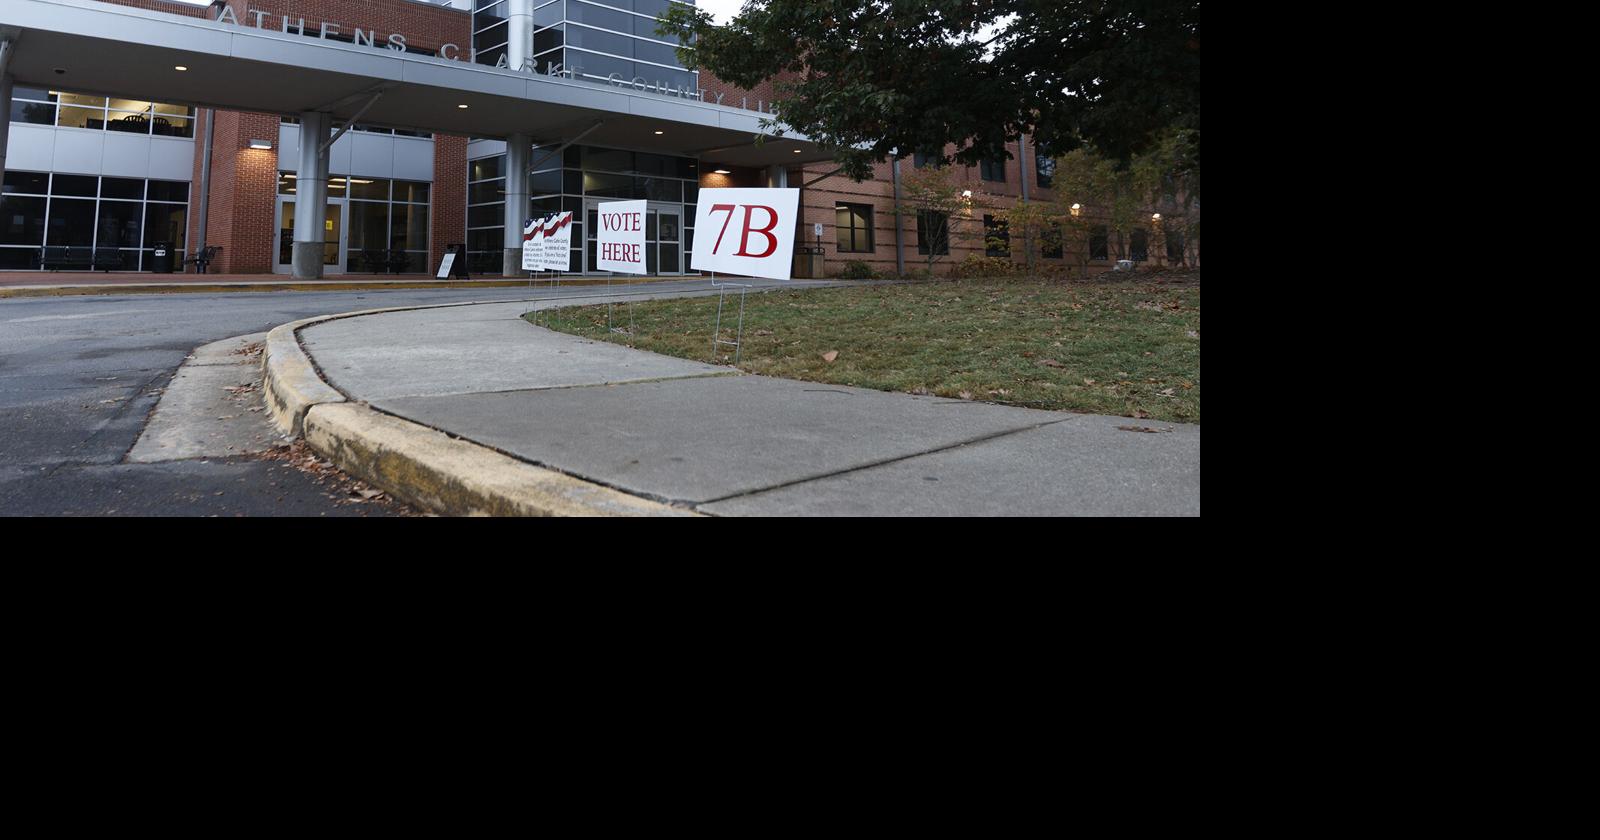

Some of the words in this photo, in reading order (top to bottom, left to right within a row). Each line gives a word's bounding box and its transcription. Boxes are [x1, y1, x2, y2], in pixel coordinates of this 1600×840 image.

[215, 5, 407, 53] ATHENS
[608, 72, 724, 105] COUNTY
[601, 212, 641, 231] VOTE
[708, 203, 779, 258] 7B
[601, 242, 641, 263] HERE
